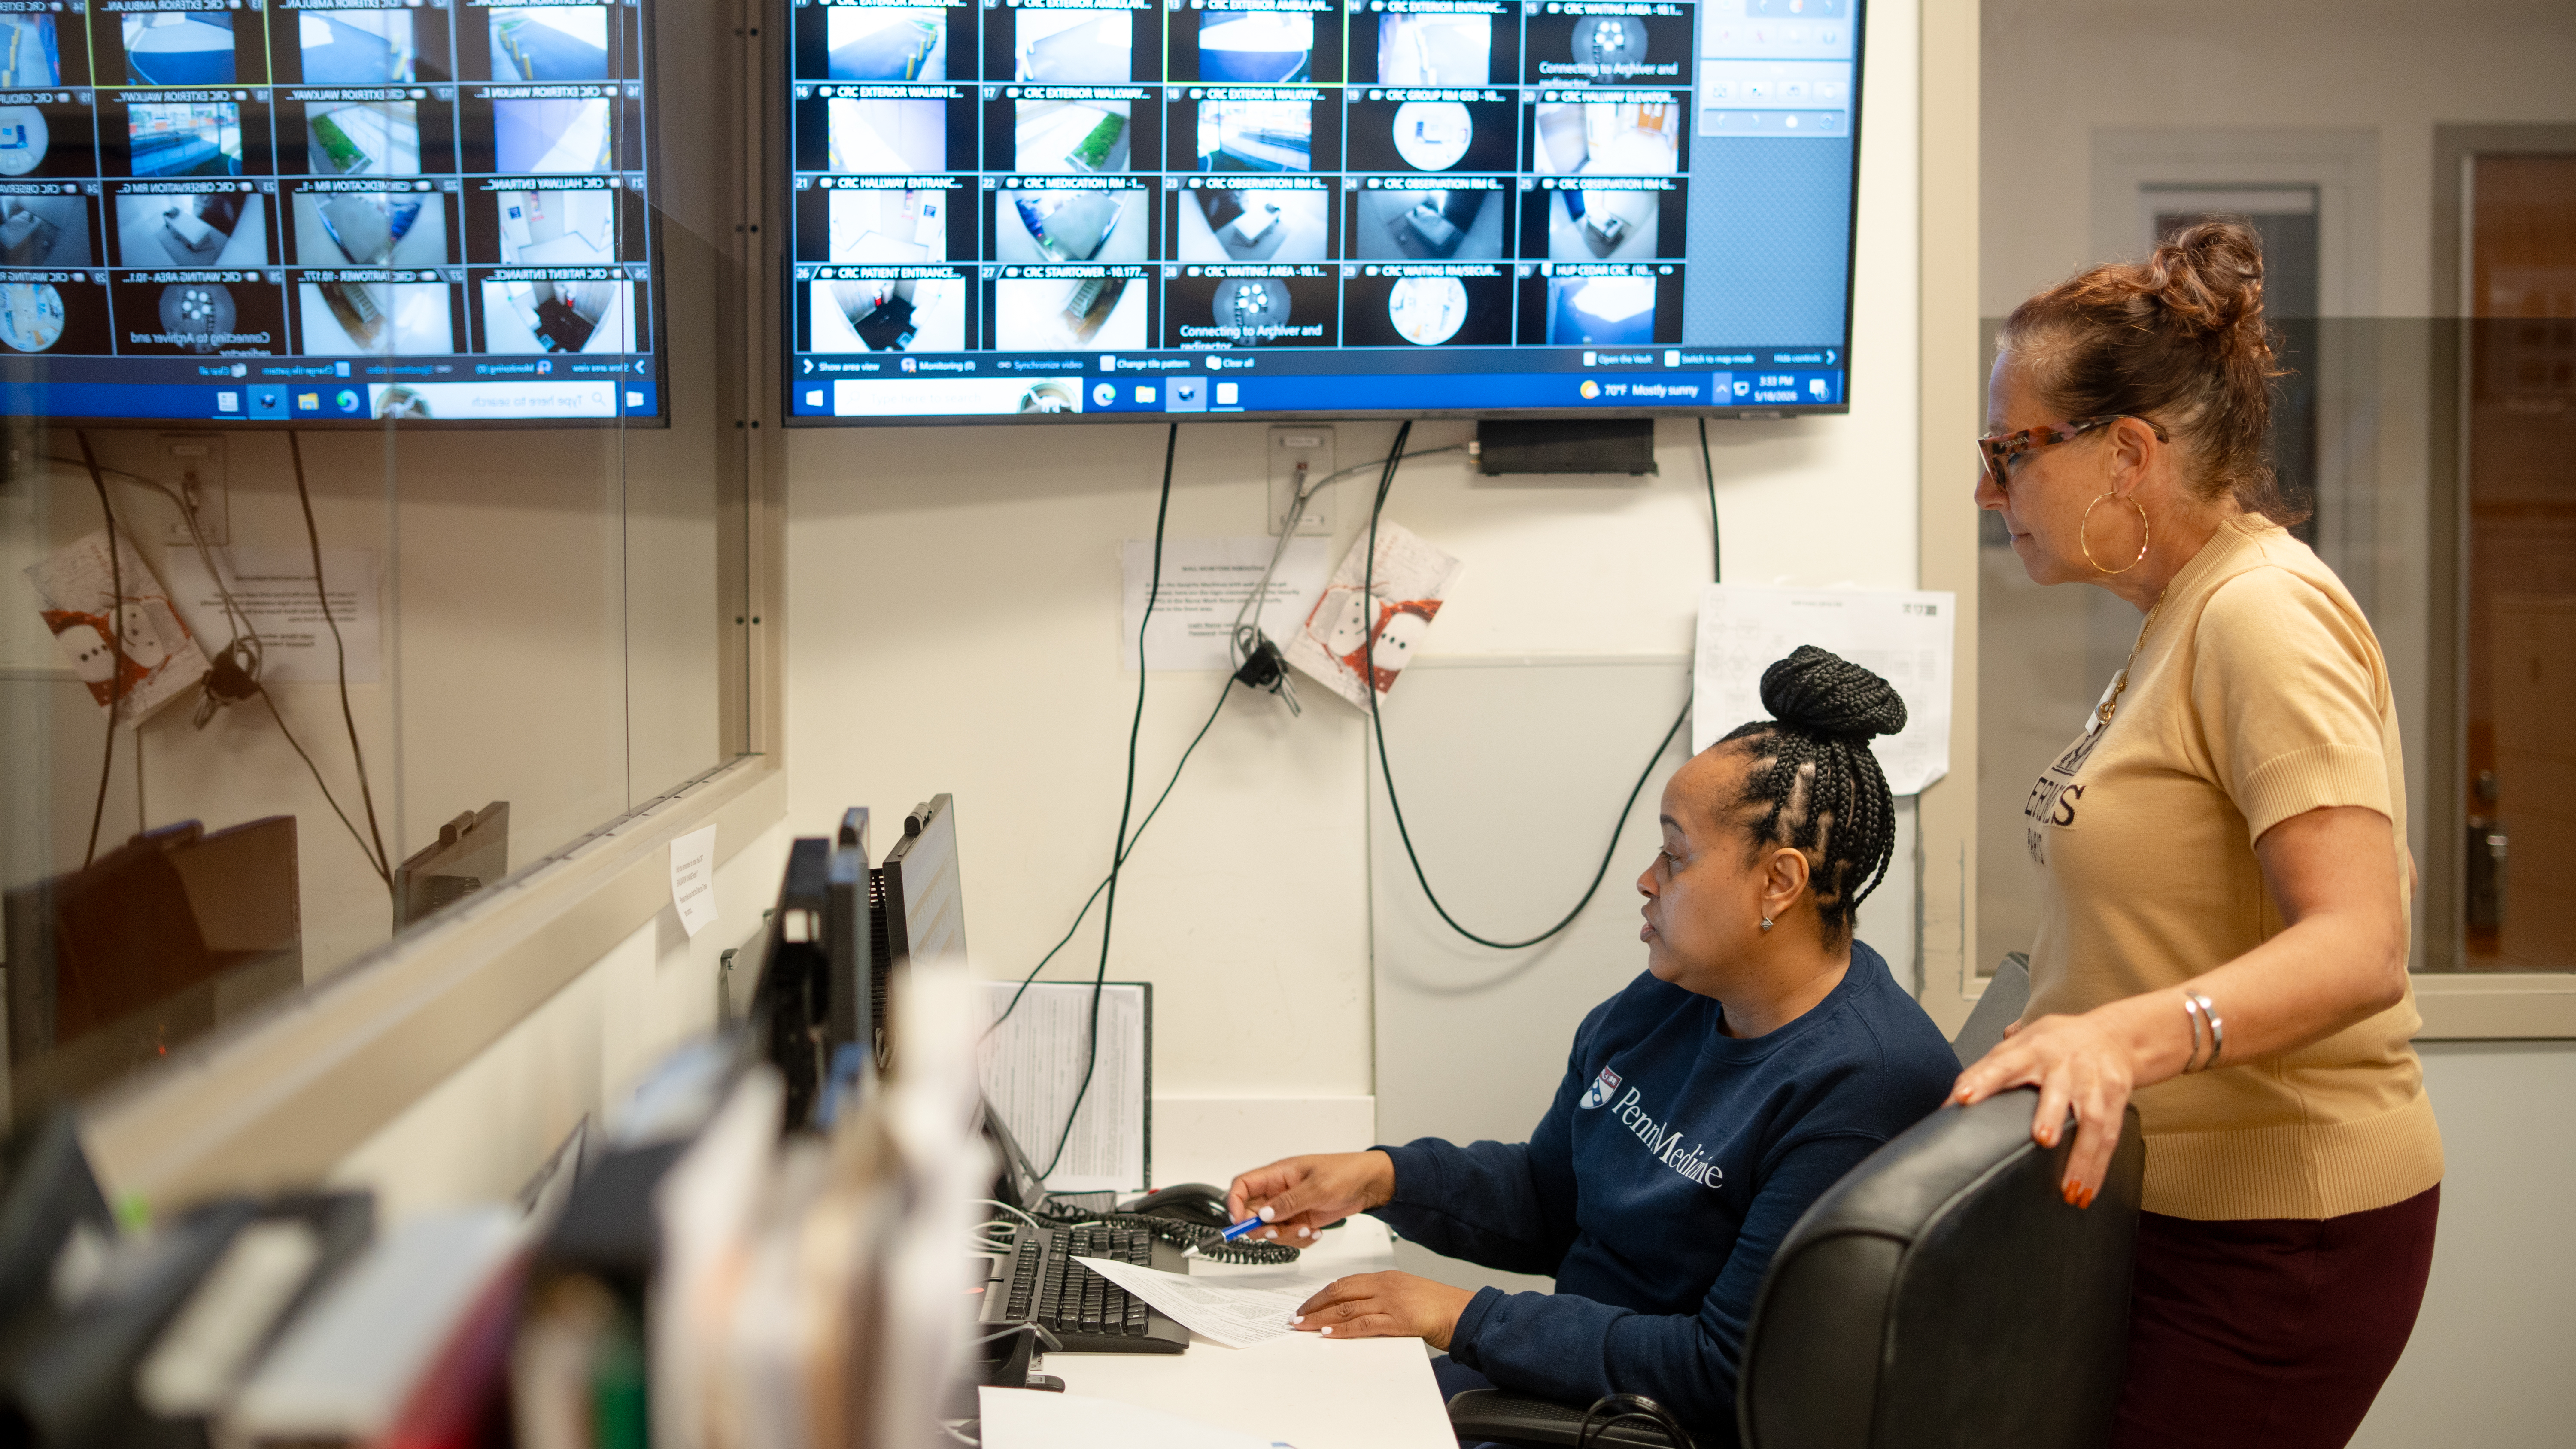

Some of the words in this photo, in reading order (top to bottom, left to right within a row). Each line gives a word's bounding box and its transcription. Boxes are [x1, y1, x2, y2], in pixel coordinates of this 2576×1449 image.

[1180, 325, 1241, 339] Connecting
[1243, 325, 1255, 336] to
[1256, 325, 1301, 340] Archiver
[1301, 325, 1323, 336] and
[1605, 384, 1627, 396] 70°F
[1632, 384, 1665, 398] Mostly
[1668, 386, 1699, 398] sunny
[871, 394, 897, 406] Type
[901, 393, 926, 403] here
[930, 395, 941, 403] to
[945, 393, 981, 403] search
[1612, 1087, 1660, 1151] Penn
